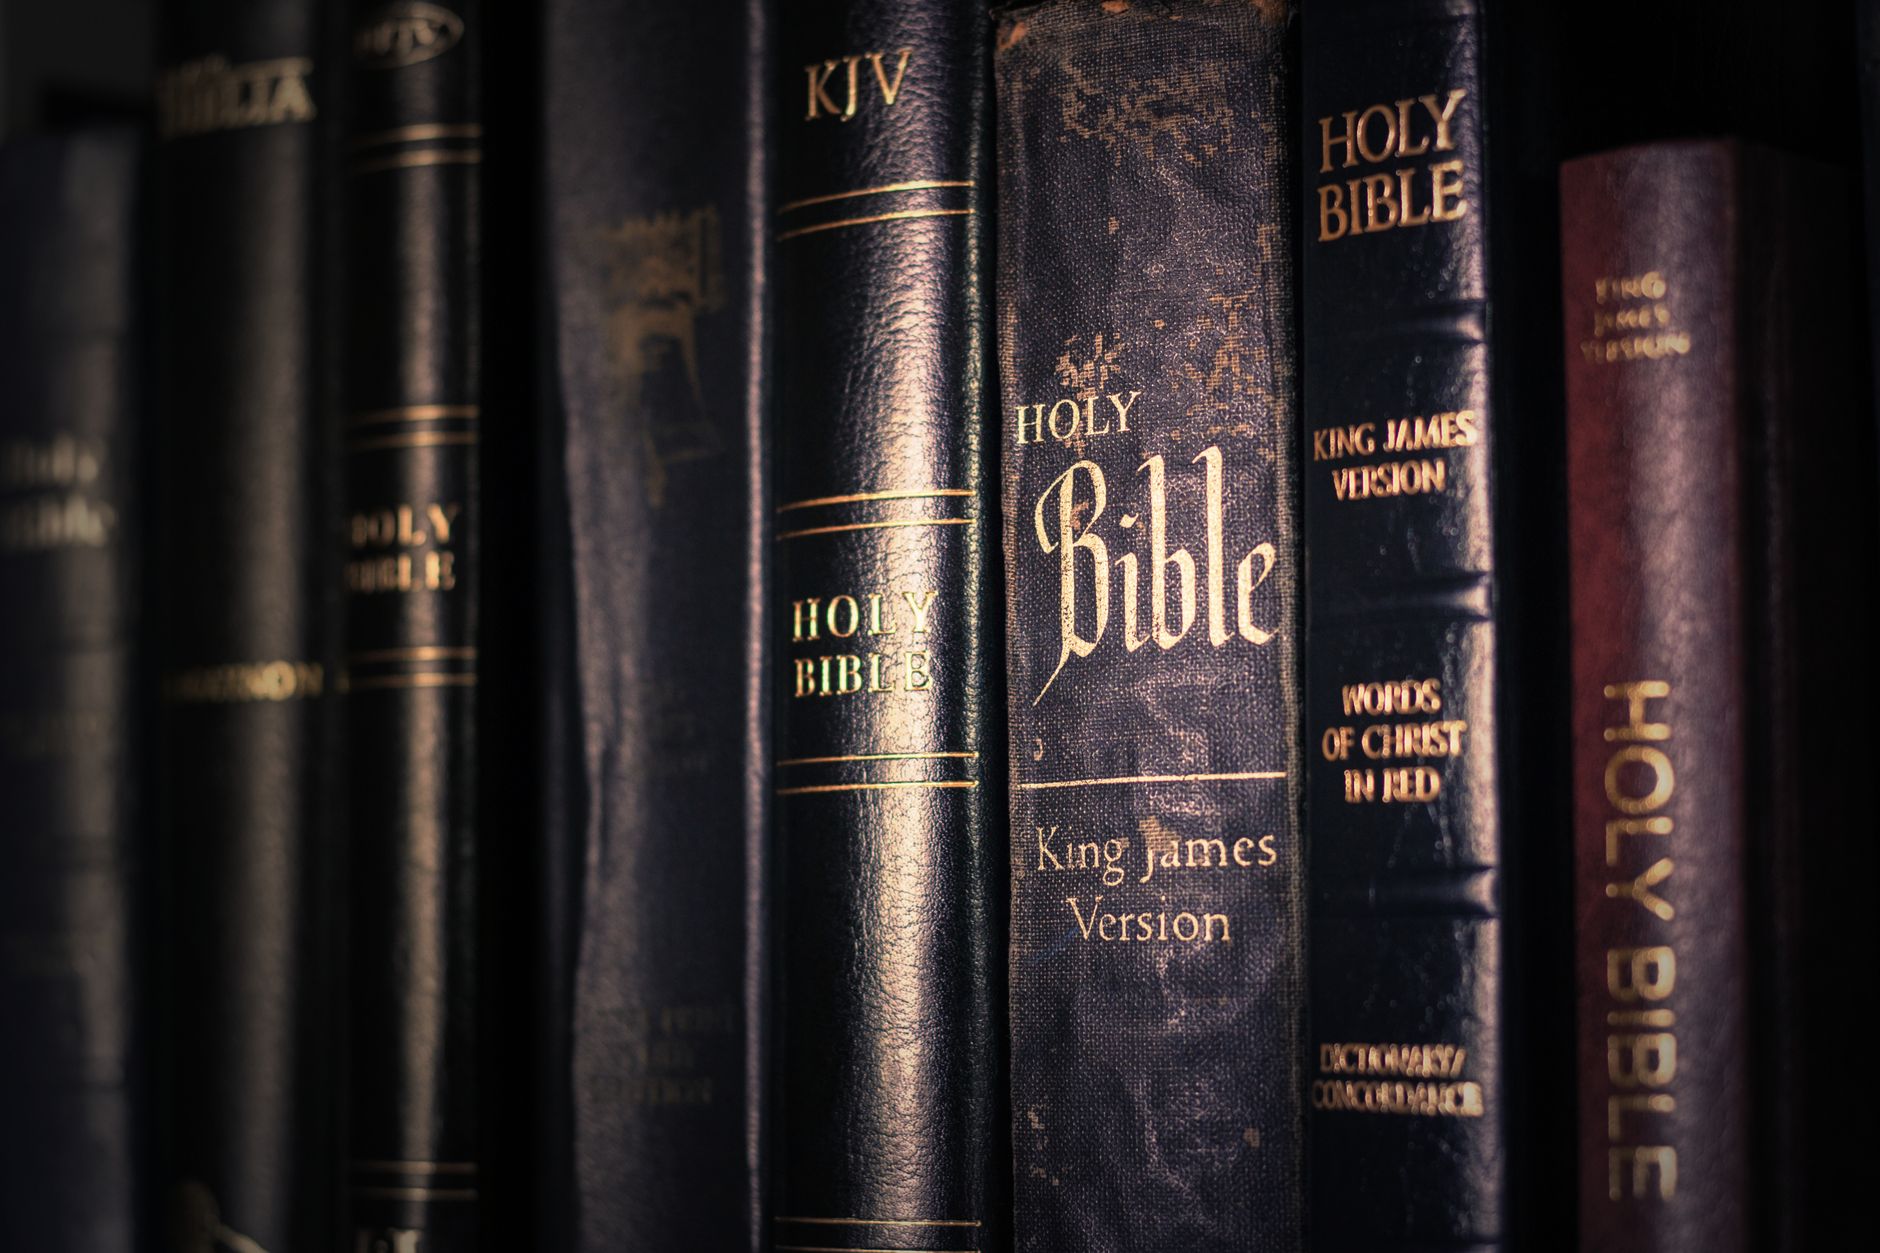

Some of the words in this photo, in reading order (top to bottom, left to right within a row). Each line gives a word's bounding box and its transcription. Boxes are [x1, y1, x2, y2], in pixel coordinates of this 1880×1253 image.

[804, 47, 913, 122] KJV
[1318, 88, 1467, 174] HOLY
[1317, 158, 1467, 242] BIBLE
[1015, 390, 1141, 445] HOLY
[1313, 421, 1376, 462] KING
[1383, 409, 1478, 452] JAMES
[1332, 456, 1447, 501] VERSION
[1032, 445, 1279, 707] Bible
[792, 591, 939, 642] HOLY
[794, 650, 933, 698] BIBLE
[1341, 677, 1441, 716] WORDS
[1322, 725, 1356, 762] OF
[1361, 719, 1468, 759] CHRIST
[1344, 768, 1375, 804] IN
[1382, 765, 1441, 803] RED
[1604, 679, 1675, 921] HOLY
[1036, 825, 1125, 887] King
[1139, 827, 1278, 884] James
[1066, 895, 1231, 942] Version
[1319, 1042, 1467, 1078] DICTIONARY/
[1606, 945, 1677, 1201] BIBLE
[1312, 1079, 1485, 1118] CONCORDANCE
